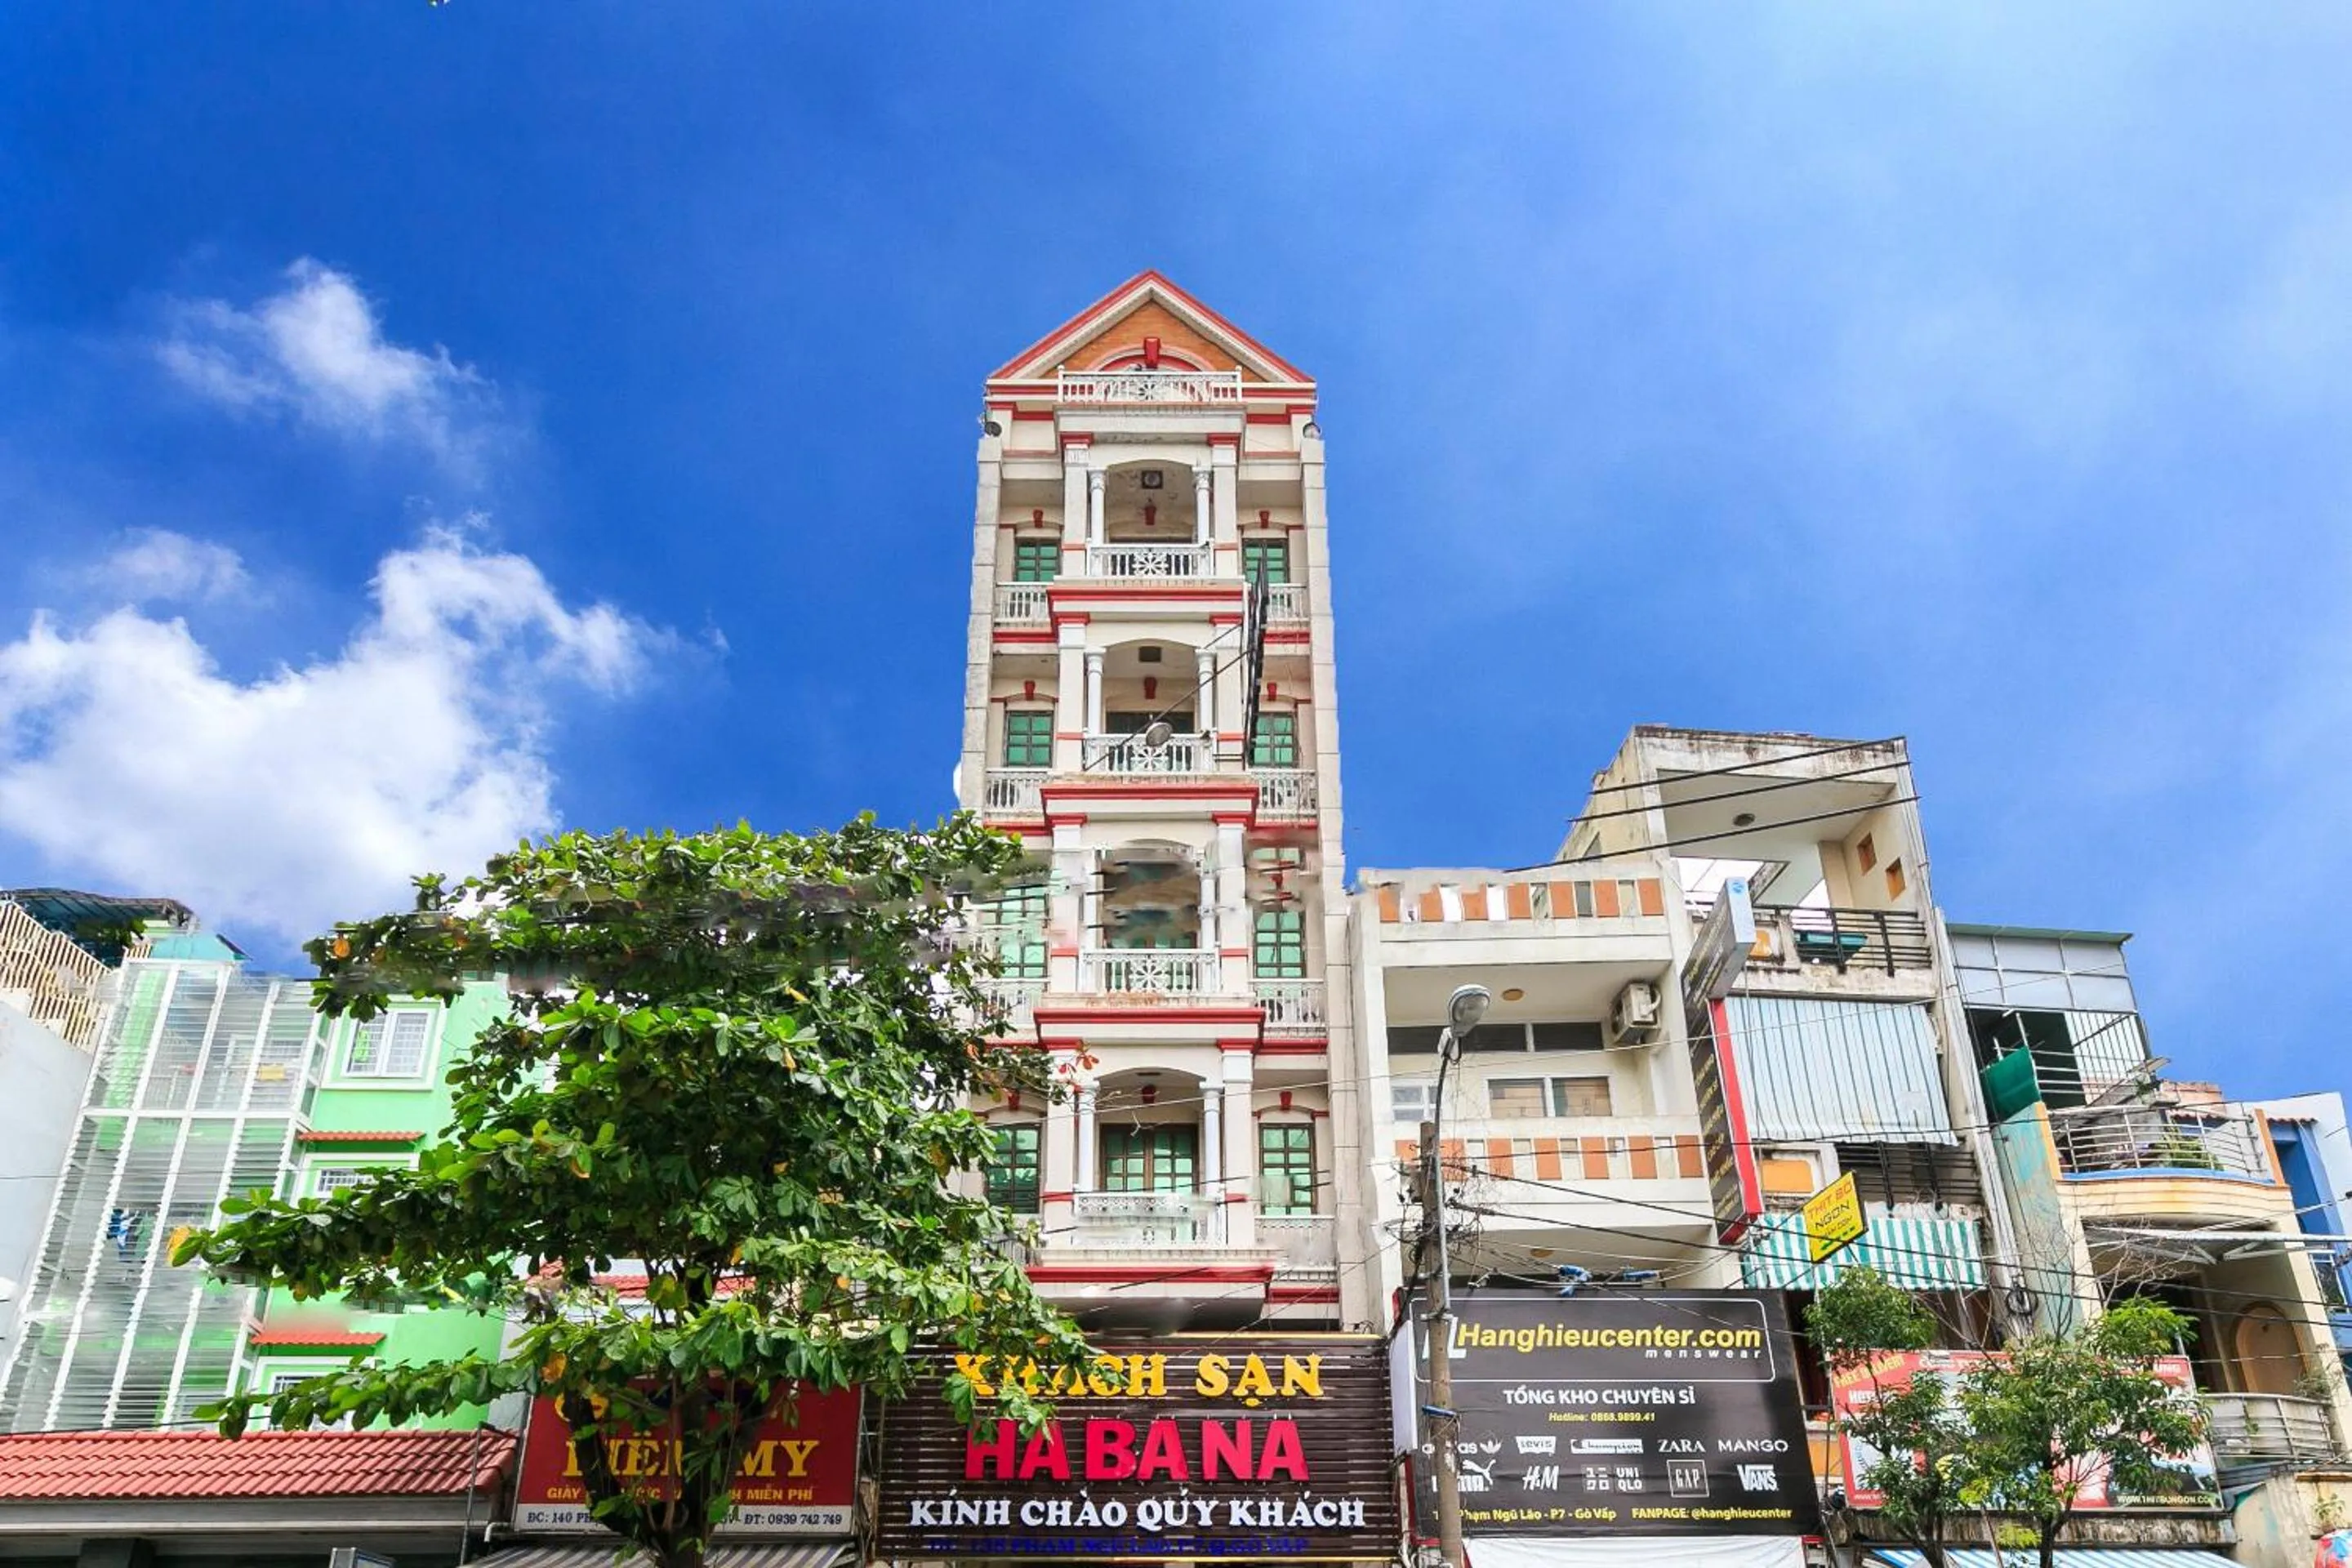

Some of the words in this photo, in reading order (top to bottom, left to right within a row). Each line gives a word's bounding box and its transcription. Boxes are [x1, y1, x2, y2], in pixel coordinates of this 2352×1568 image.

[1457, 1321, 1761, 1353] Hanghieucenter.com
[1645, 1348, 1762, 1359] menswear
[1195, 1352, 1325, 1407] SẠN
[1558, 1390, 1599, 1405] KHO
[1601, 1386, 1675, 1405] CHUYÊN
[1548, 1412, 1588, 1423] Hotline:
[1658, 1439, 1706, 1453] ZARA
[1717, 1439, 1789, 1452] MANGO
[1522, 1465, 1560, 1491] H&M
[1674, 1468, 1700, 1489] GAP
[1737, 1464, 1780, 1492] VANS
[788, 1486, 813, 1501] PHÍ
[909, 1487, 1011, 1526] KÍNH
[1020, 1486, 1128, 1527] CHÀO
[1229, 1490, 1366, 1527] KHÁCH
[1632, 1508, 1689, 1520] FANPAGE:
[1691, 1508, 1793, 1522] @hanghieucenter
